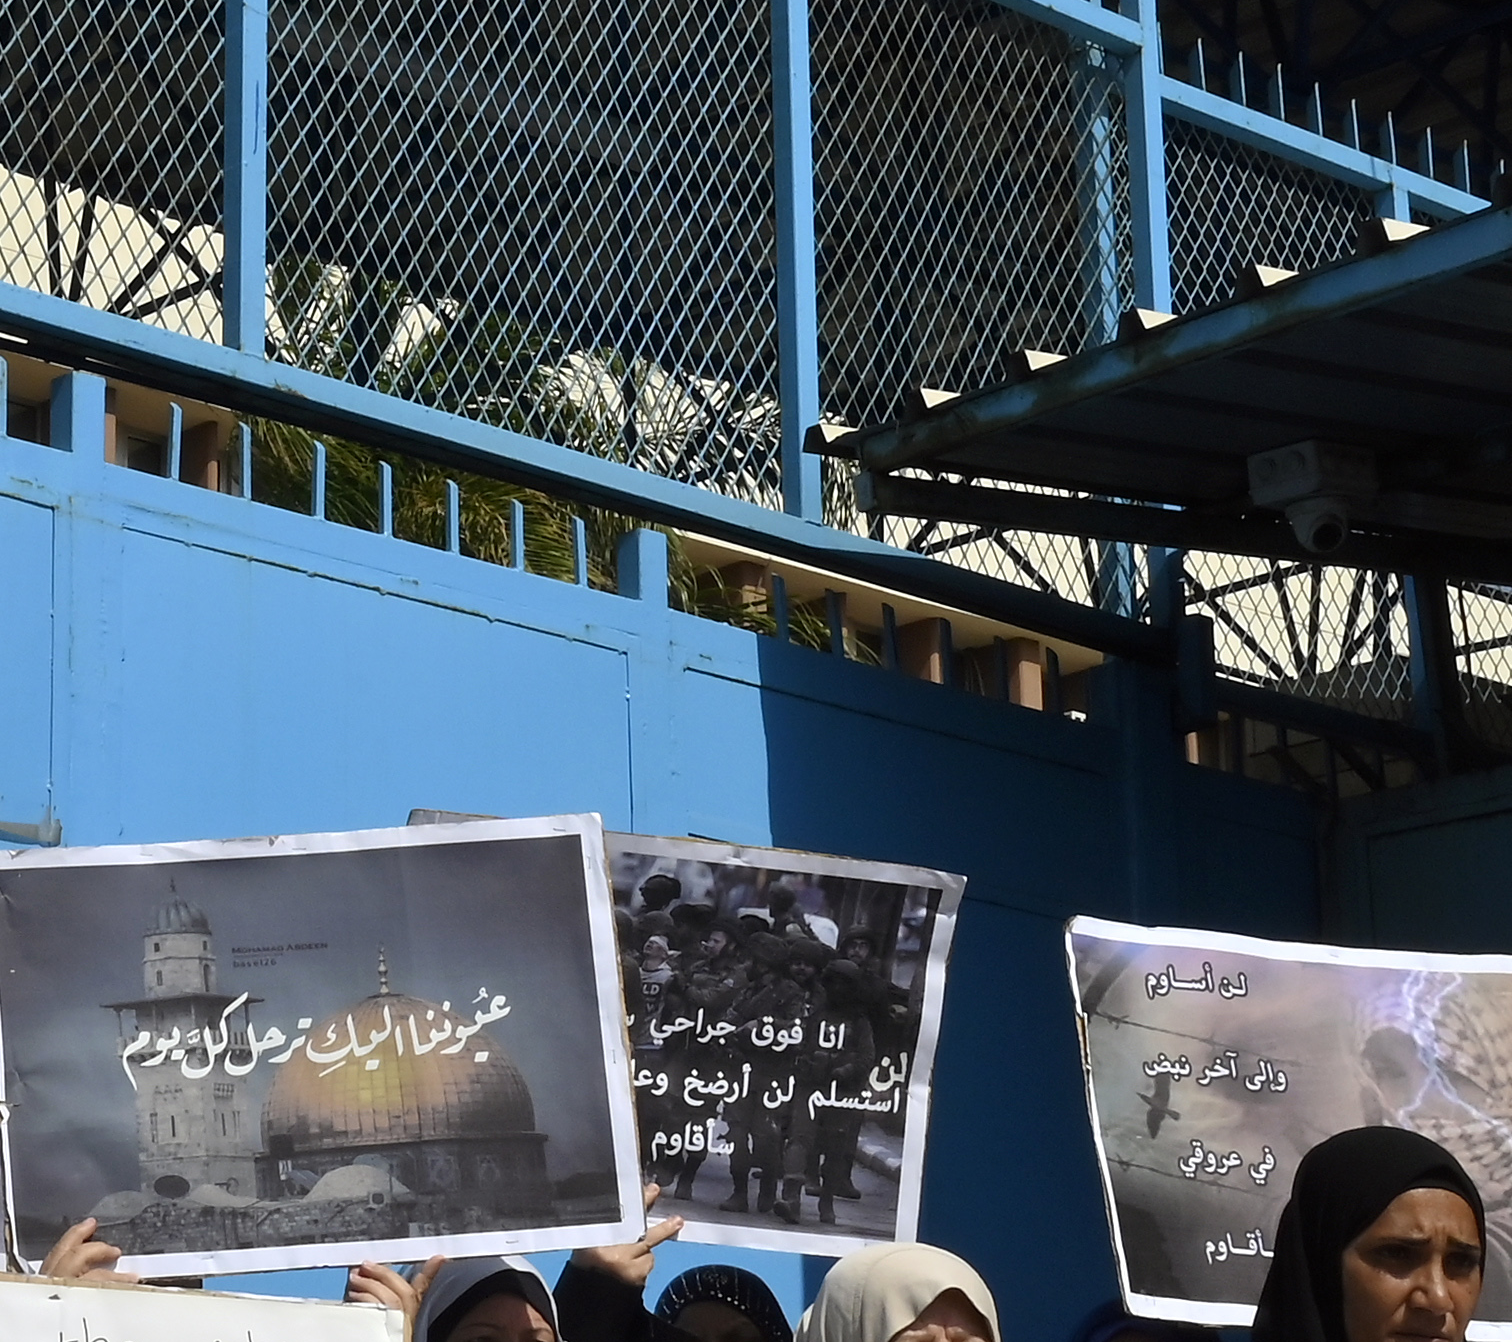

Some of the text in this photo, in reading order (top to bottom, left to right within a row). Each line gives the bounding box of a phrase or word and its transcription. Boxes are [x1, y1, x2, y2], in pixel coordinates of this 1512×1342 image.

[233, 959, 277, 968] basel26
[1146, 963, 1247, 999] لن أساوم
[649, 1008, 845, 1051] انا فوق جراحي
[122, 1027, 182, 1091] يوم
[869, 1052, 909, 1091] لن
[1145, 1052, 1288, 1091] وإلى آخر نبض
[683, 1063, 752, 1106] أرضخ
[763, 1075, 795, 1109] لن
[808, 1080, 900, 1121] استسلم
[651, 1118, 734, 1161] سأقاوم
[1180, 1141, 1276, 1185] في عروقي
[1205, 1229, 1274, 1265] أقاوم
